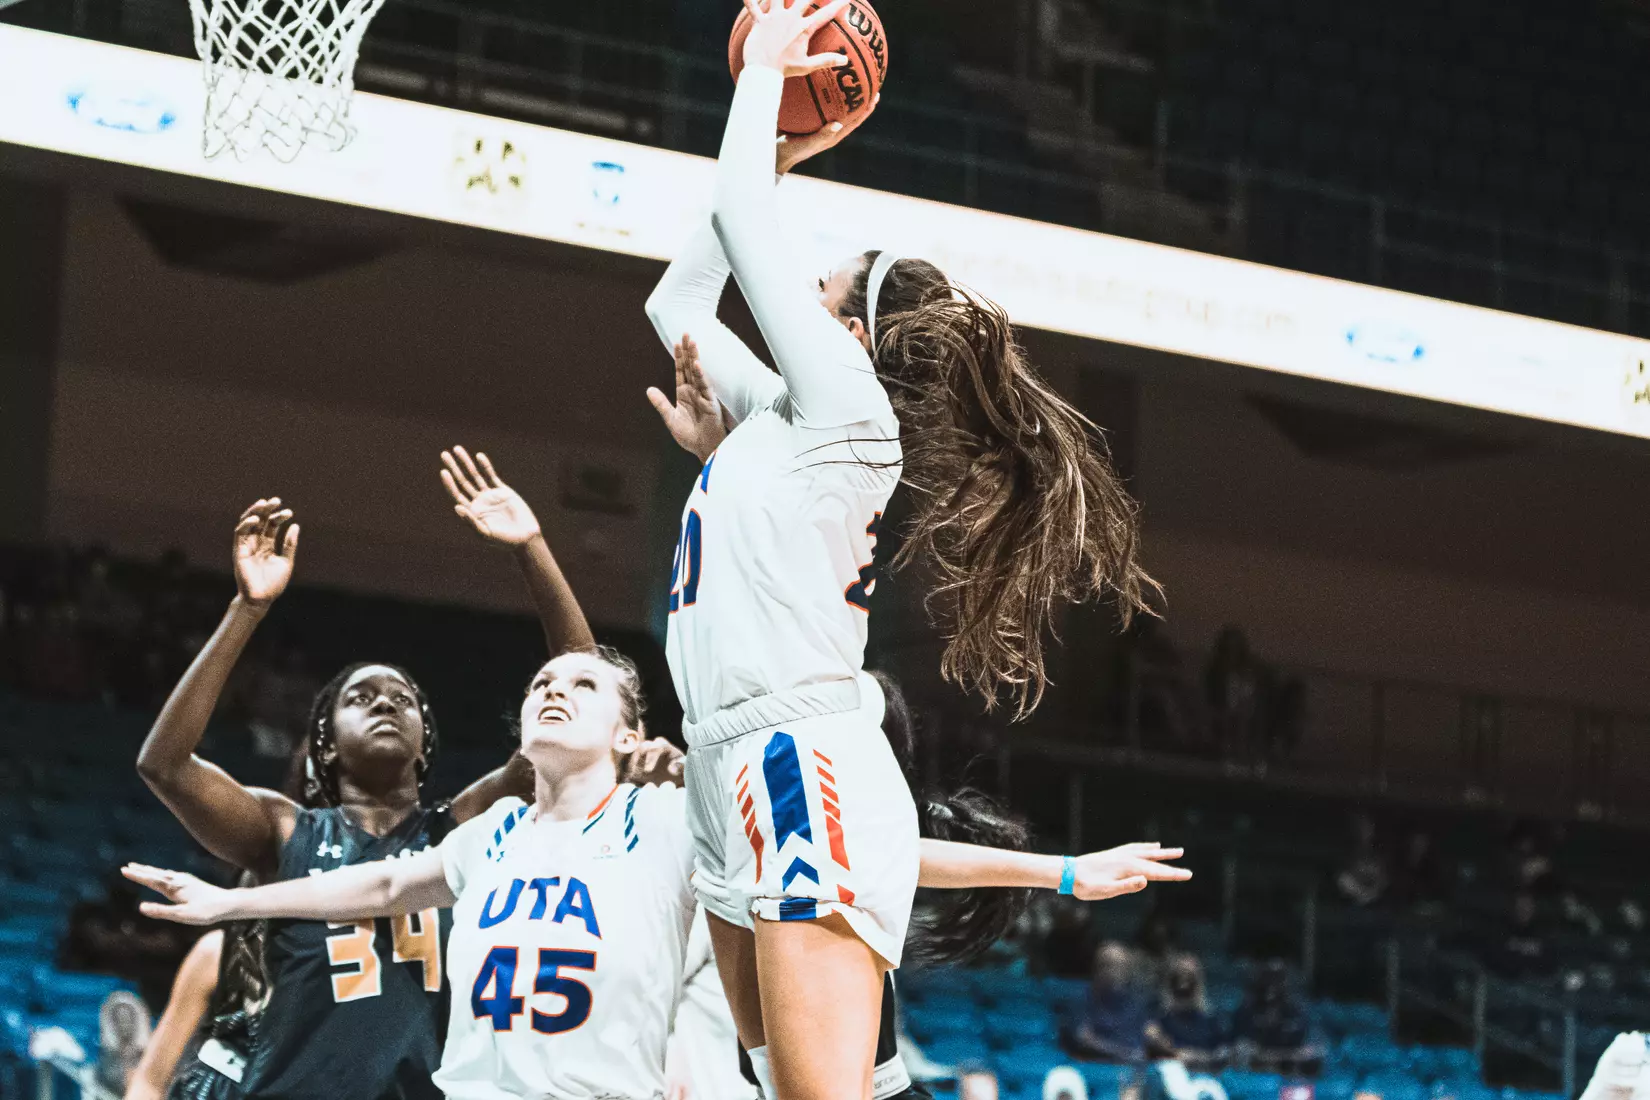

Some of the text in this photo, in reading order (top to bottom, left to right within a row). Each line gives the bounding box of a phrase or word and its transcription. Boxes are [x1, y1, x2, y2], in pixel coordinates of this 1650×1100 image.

[848, 3, 886, 83] Wilso
[478, 876, 602, 940] UTA
[326, 907, 442, 1003] 34
[471, 946, 597, 1036] 45
